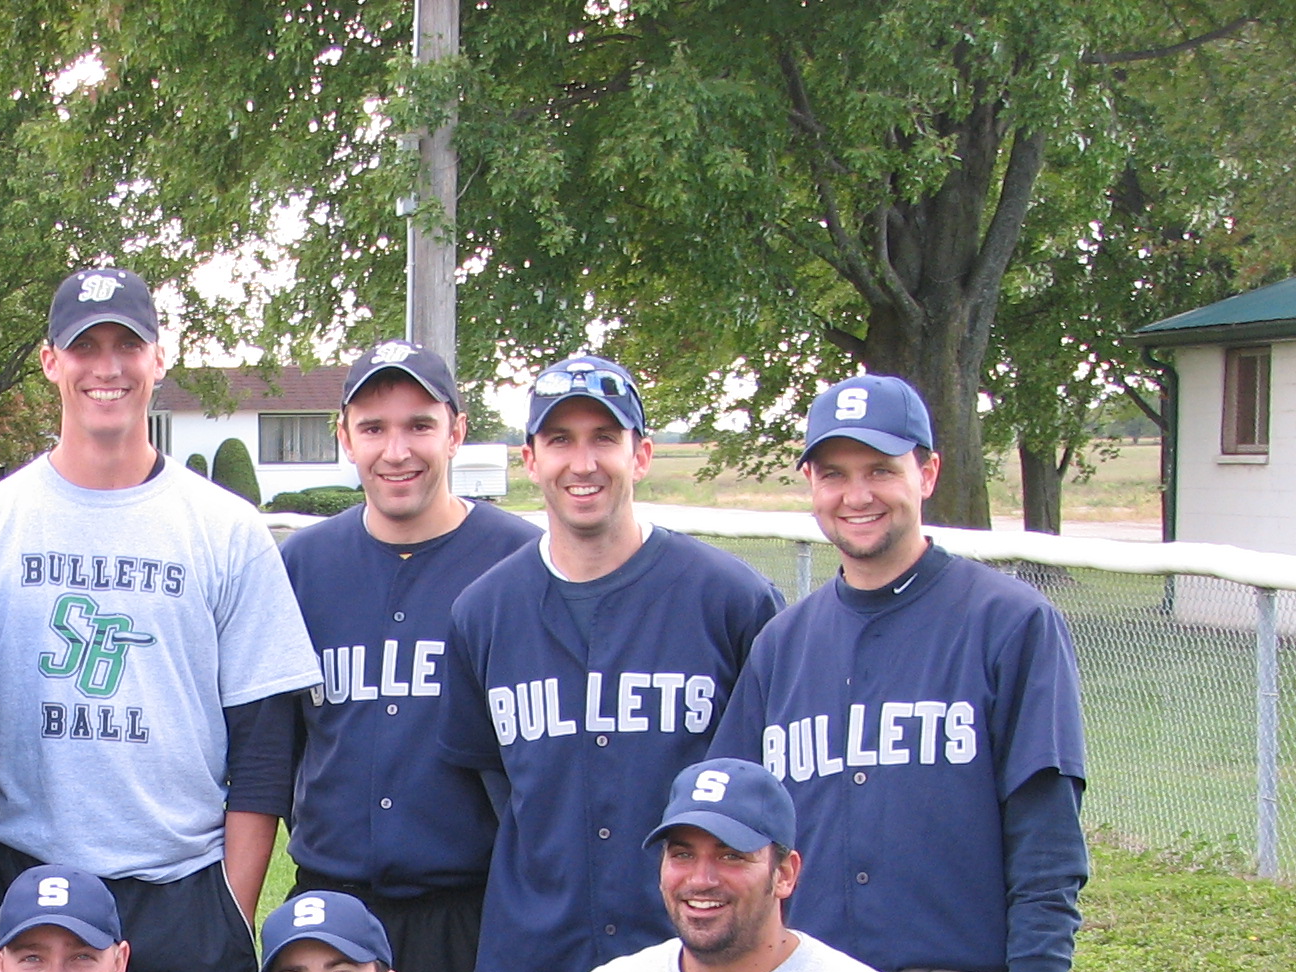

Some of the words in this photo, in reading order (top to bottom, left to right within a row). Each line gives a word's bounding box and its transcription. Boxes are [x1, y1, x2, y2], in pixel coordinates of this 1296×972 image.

[836, 388, 868, 420] S
[21, 552, 186, 598] BULLETS
[310, 640, 445, 706] ULLE
[41, 702, 150, 744] BALL
[488, 671, 715, 746] BULLETS
[763, 701, 977, 783] BULLETS
[692, 770, 729, 802] S
[38, 877, 68, 906] S
[294, 897, 324, 927] S
